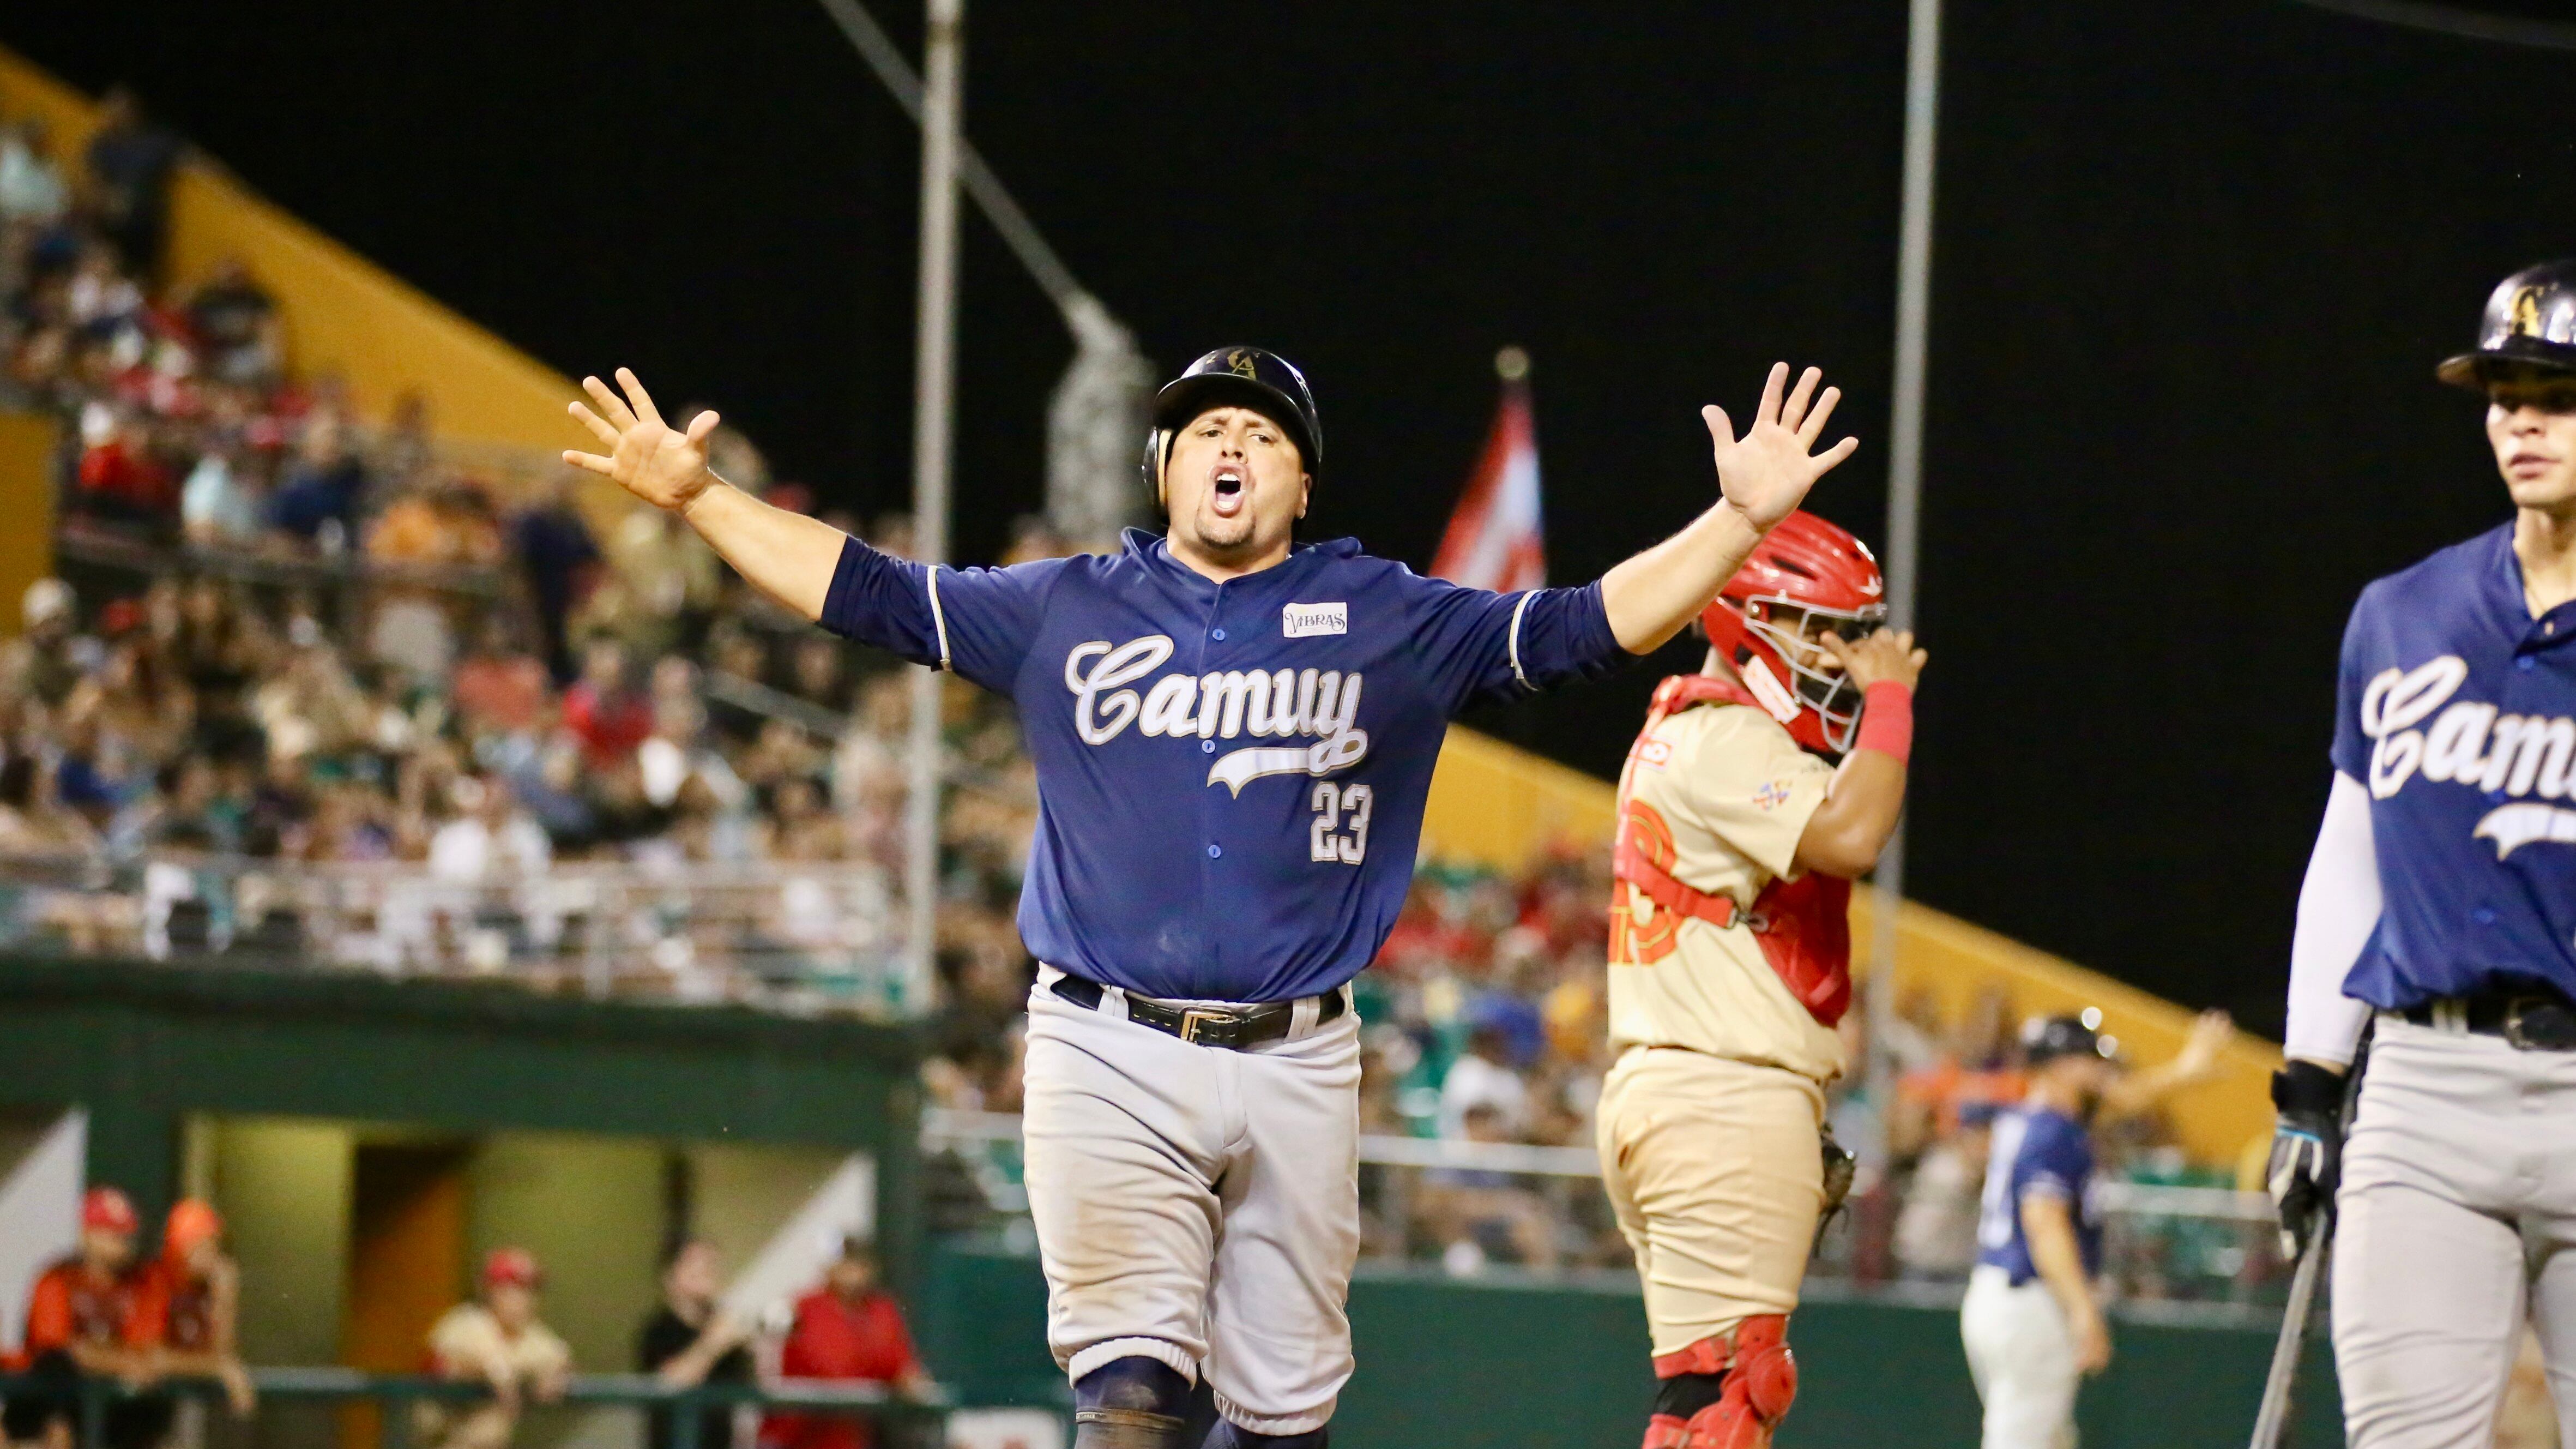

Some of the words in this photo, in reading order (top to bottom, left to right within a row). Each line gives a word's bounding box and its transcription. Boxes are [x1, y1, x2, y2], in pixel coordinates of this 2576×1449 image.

[1065, 635, 1367, 777] Camuy
[2361, 656, 2576, 800] Cam
[1311, 781, 1373, 865] 23
